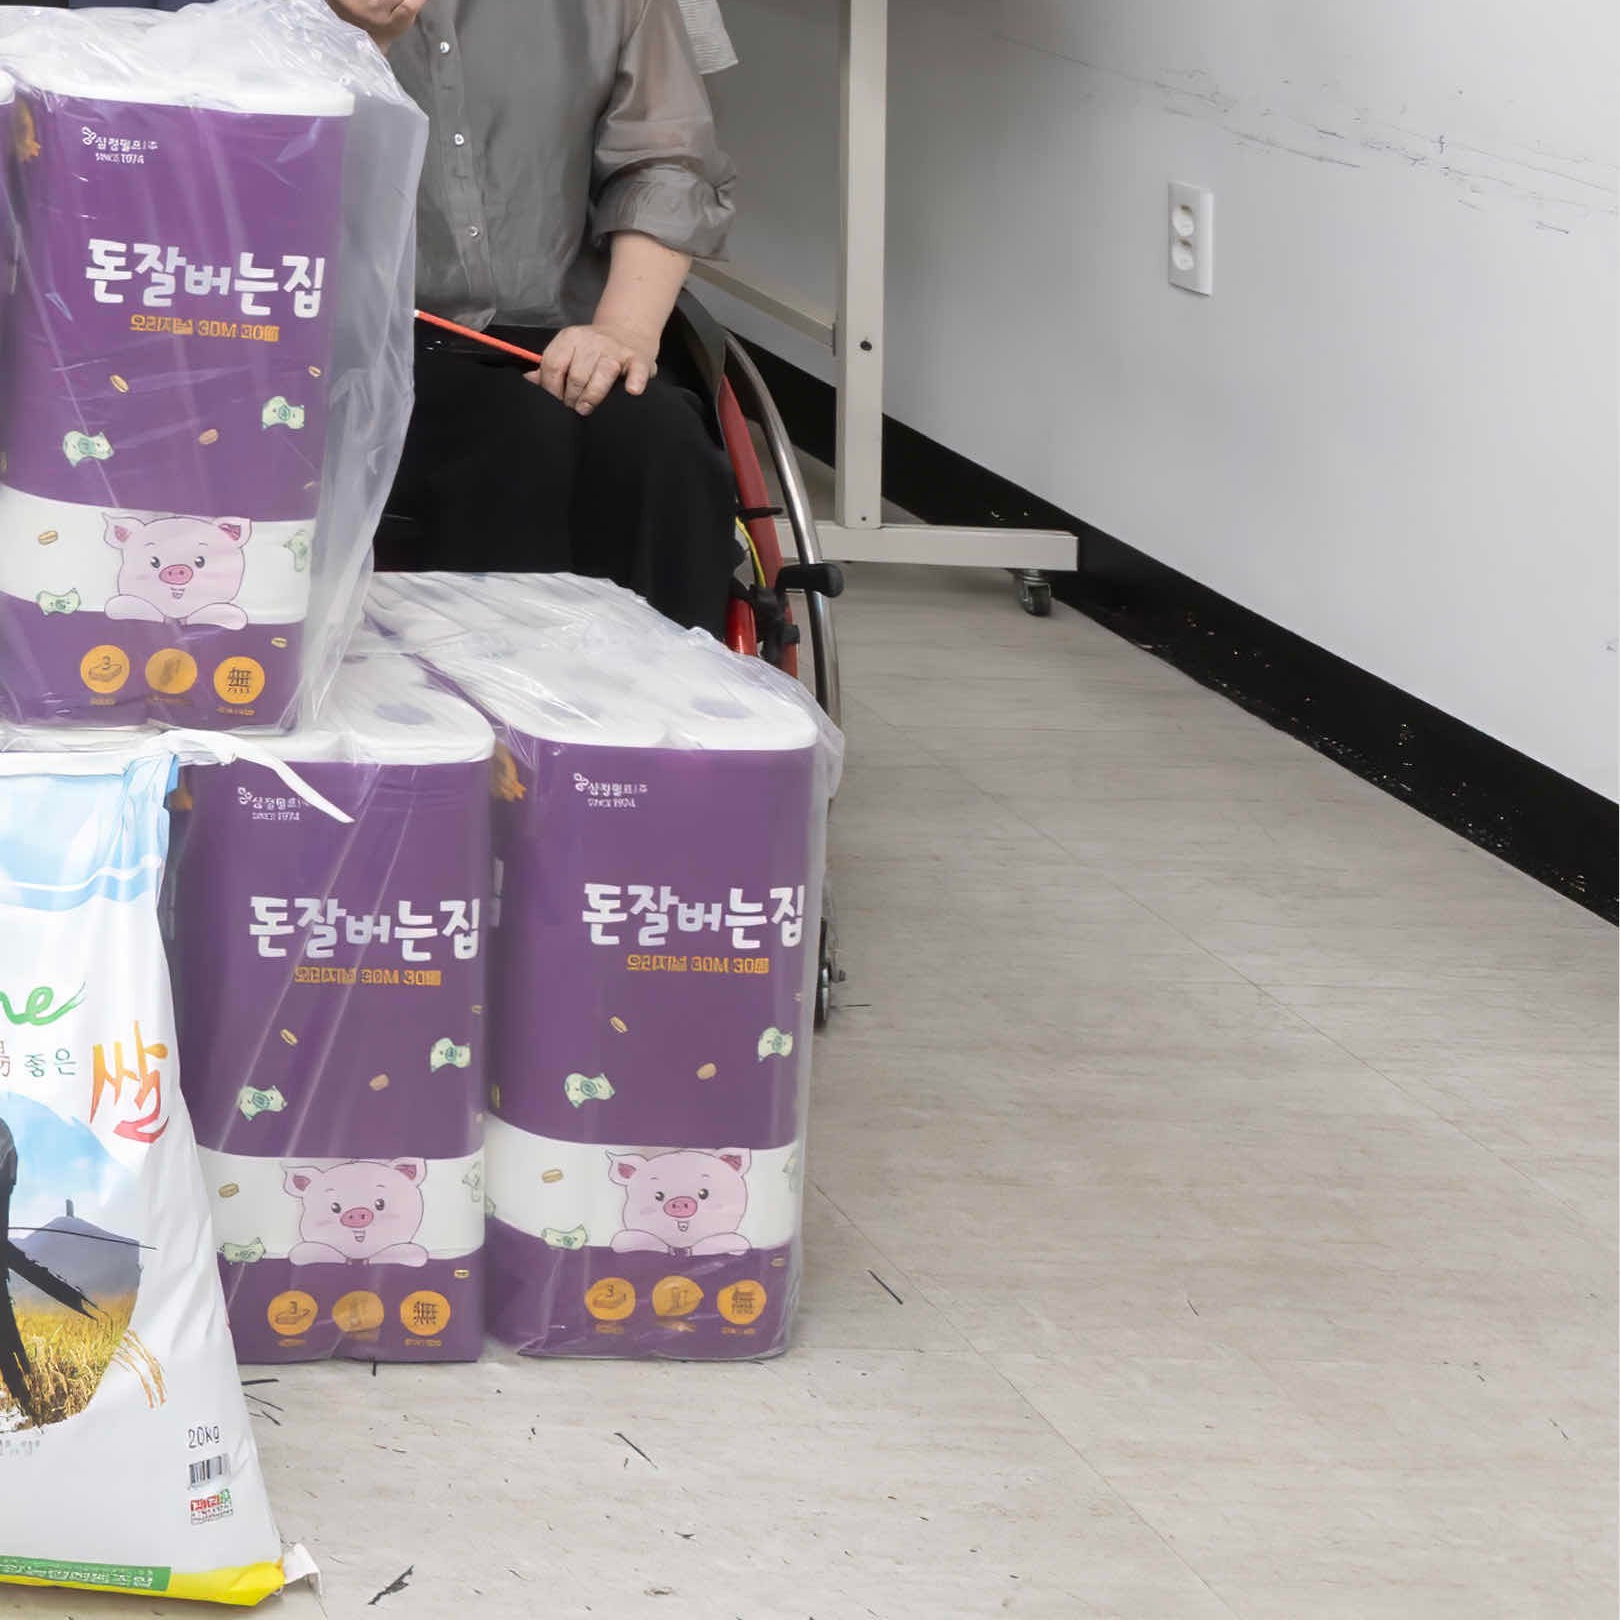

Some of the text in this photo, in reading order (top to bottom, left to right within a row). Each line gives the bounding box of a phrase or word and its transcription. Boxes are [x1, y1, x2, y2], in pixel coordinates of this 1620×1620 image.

[85, 238, 326, 319] 돈잘버는집
[249, 895, 481, 962] 돈잘버는집
[582, 882, 806, 950] 돈잘버는집
[24, 1047, 78, 1078] 좋은
[90, 1019, 169, 1144] 쌀
